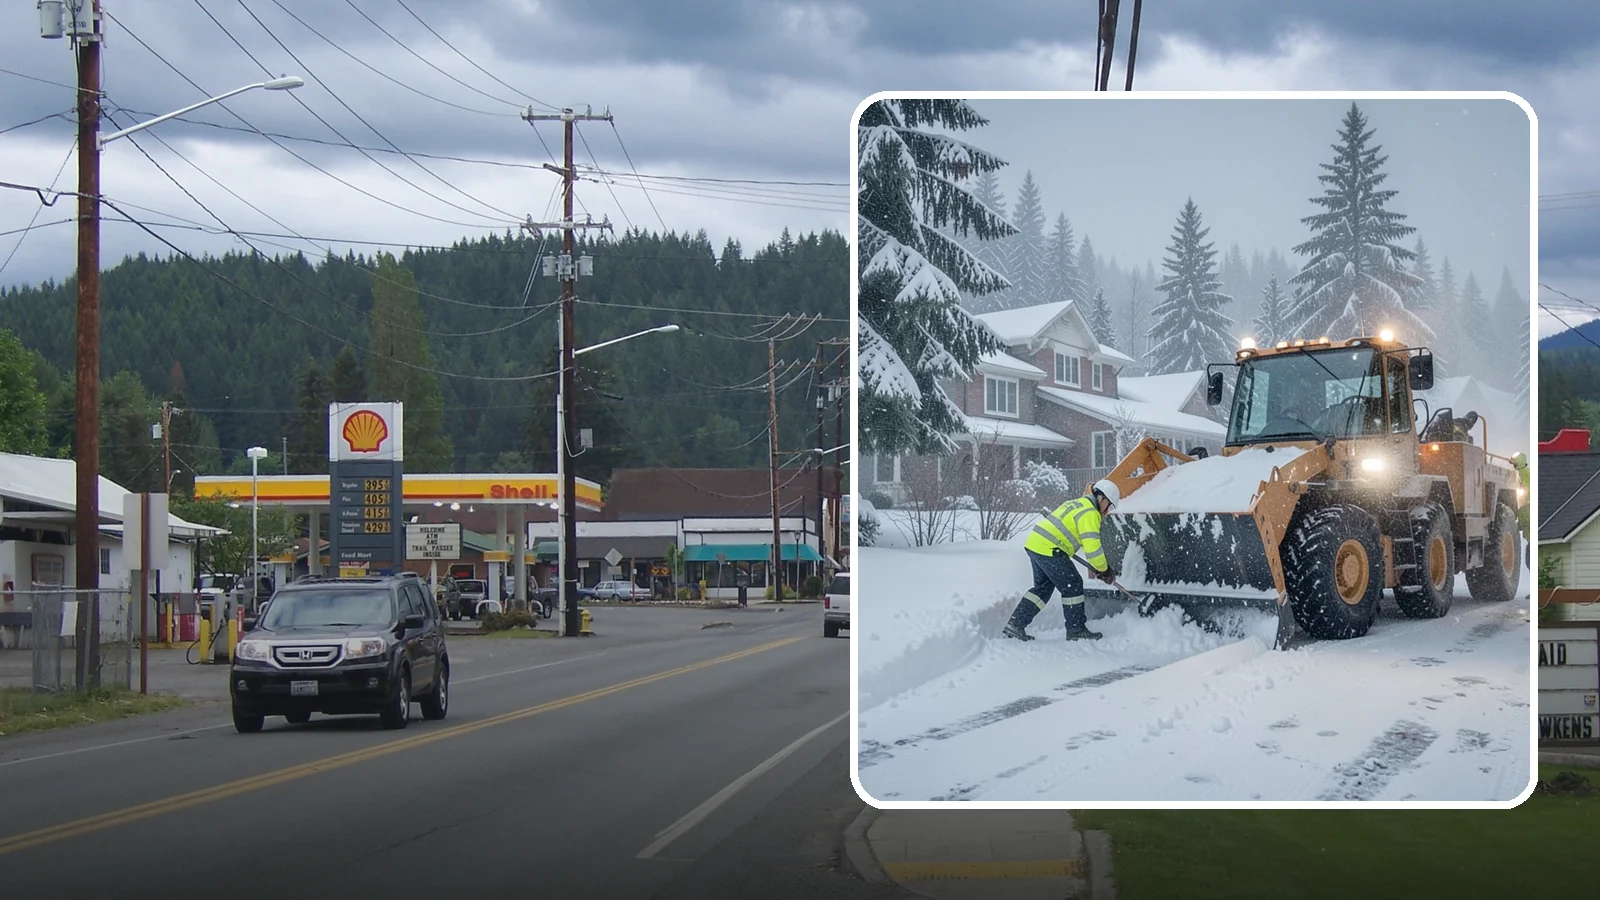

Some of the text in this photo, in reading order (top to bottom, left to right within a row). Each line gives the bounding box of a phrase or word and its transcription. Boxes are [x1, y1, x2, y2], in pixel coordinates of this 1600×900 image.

[365, 480, 383, 490] 395
[490, 484, 547, 499] Shell
[365, 494, 383, 504] 405
[365, 508, 383, 517] 415
[366, 523, 383, 533] 429
